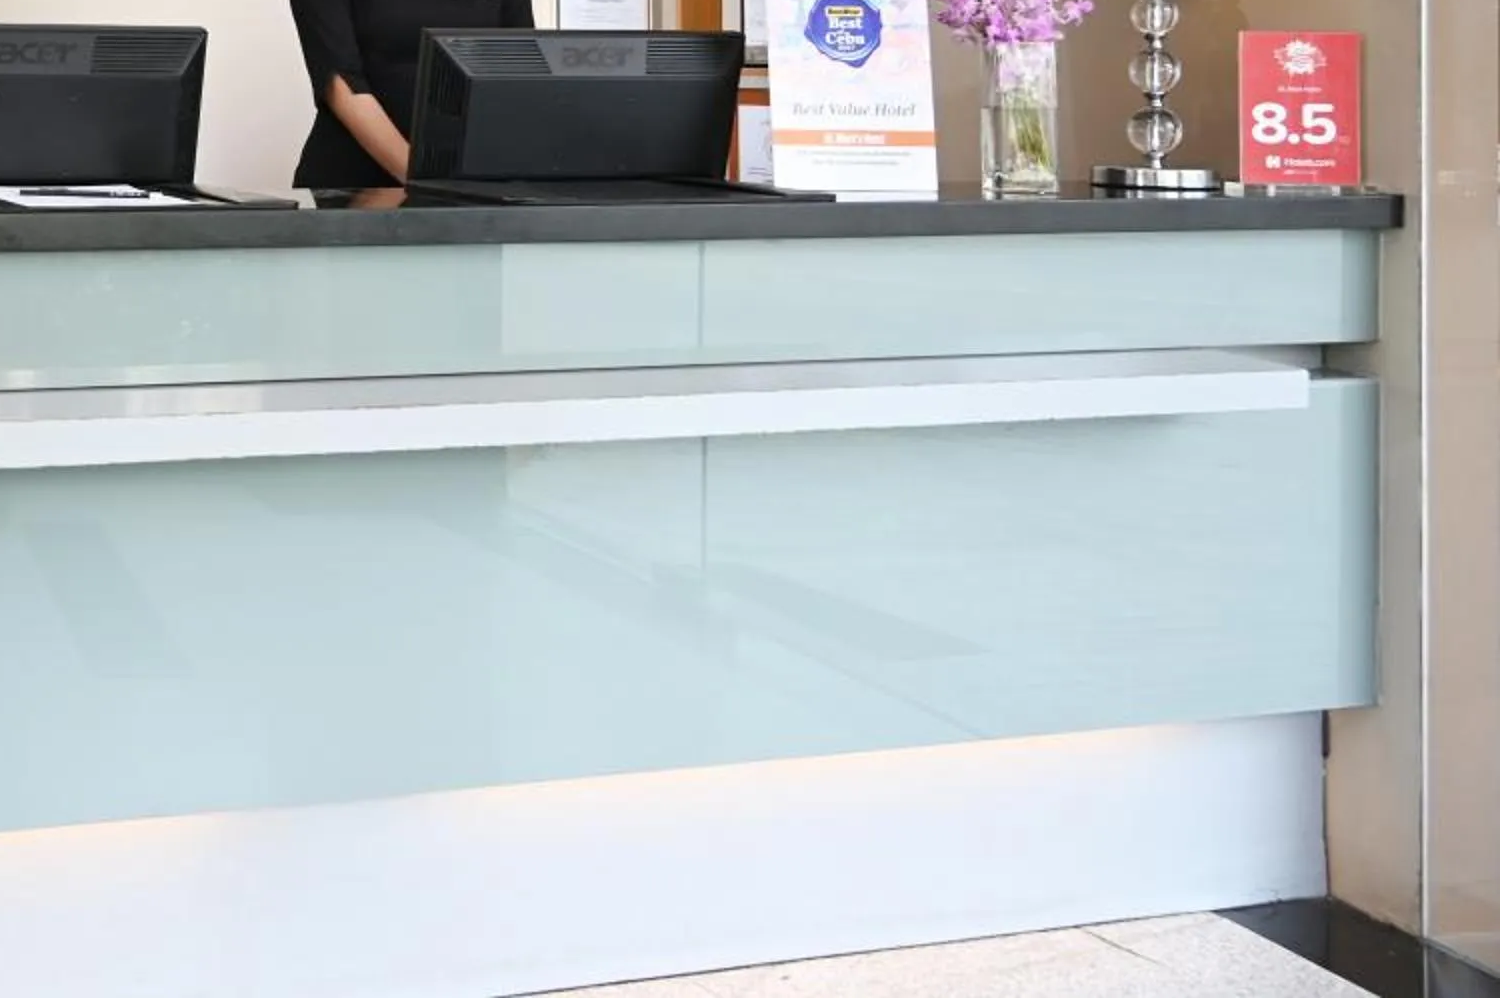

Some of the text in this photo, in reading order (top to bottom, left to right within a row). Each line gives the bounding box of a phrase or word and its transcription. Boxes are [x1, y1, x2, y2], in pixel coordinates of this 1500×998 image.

[828, 16, 863, 30] Best
[825, 31, 865, 45] Cebu
[561, 46, 635, 68] acer
[792, 102, 918, 117] Best Value Hotel
[1251, 102, 1337, 145] 8.5
